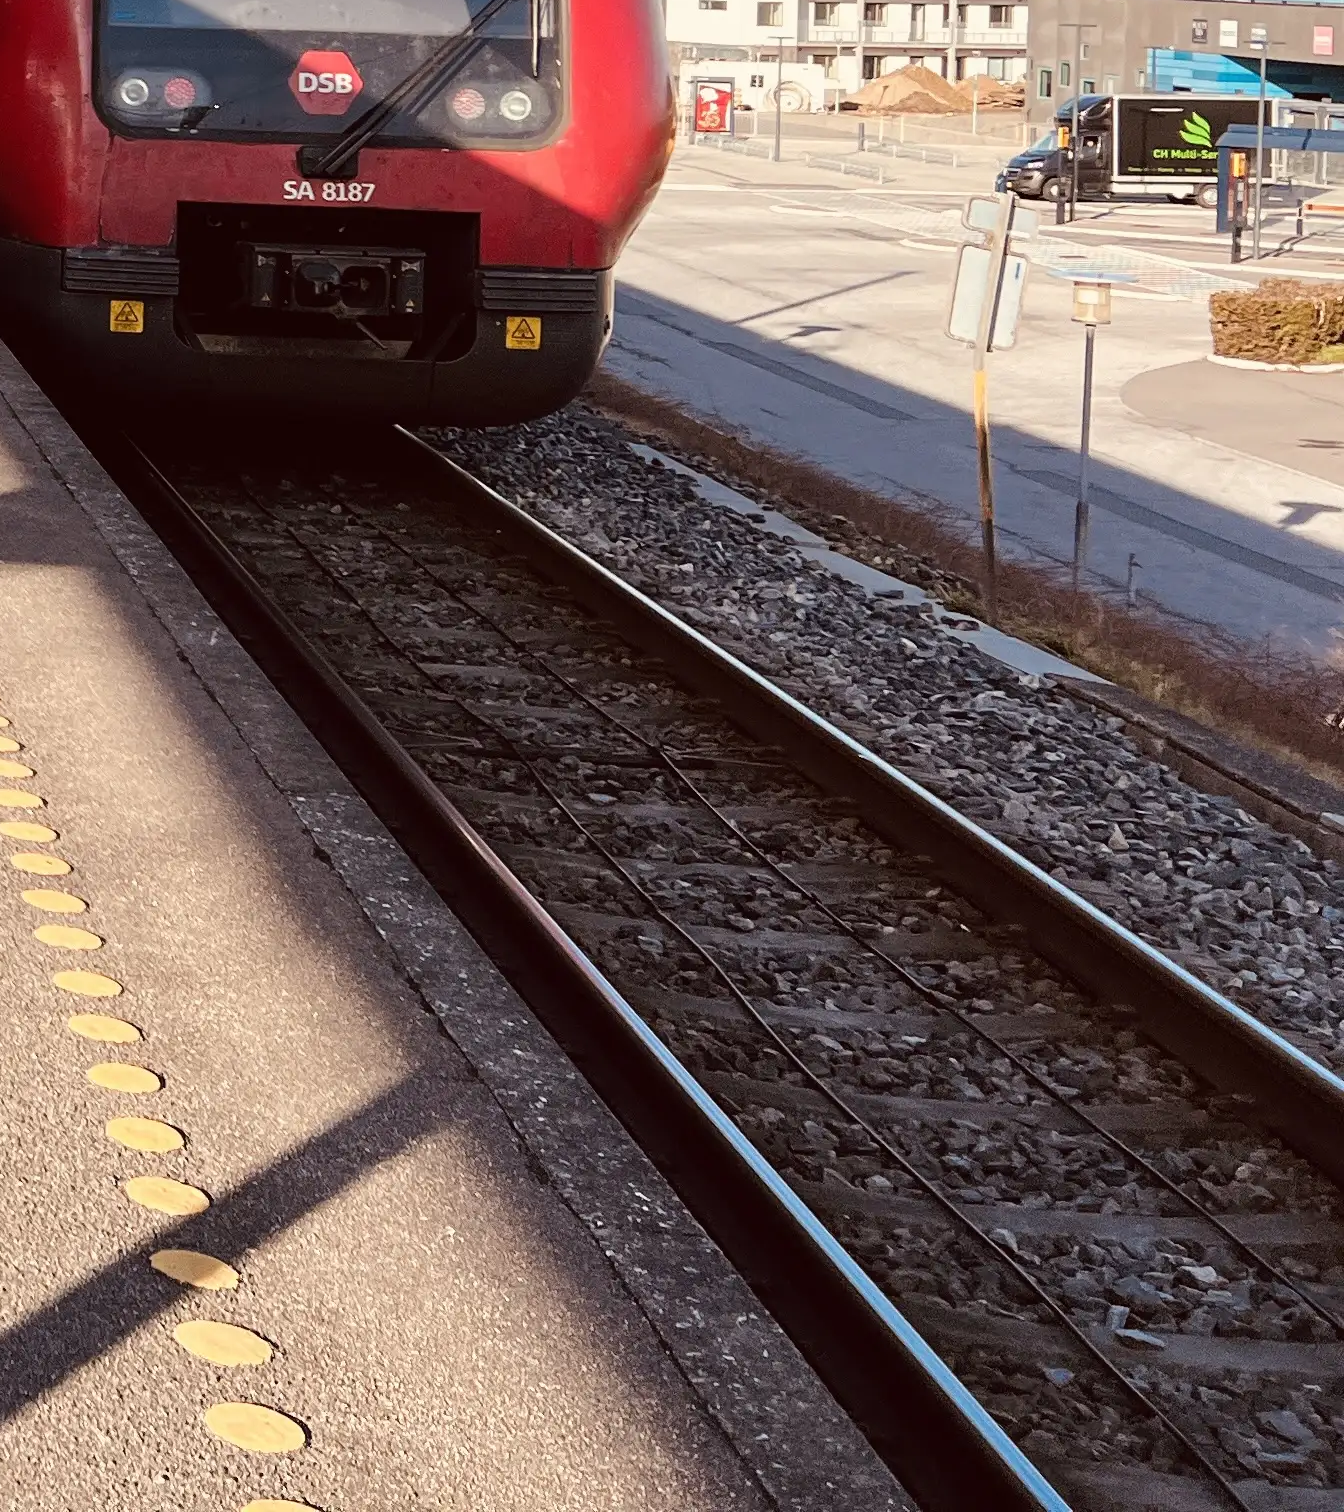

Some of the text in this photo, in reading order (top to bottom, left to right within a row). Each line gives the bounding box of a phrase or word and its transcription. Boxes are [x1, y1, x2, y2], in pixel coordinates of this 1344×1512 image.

[298, 72, 353, 94] DSB
[1153, 149, 1168, 159] CH
[283, 180, 376, 202] SA 8187
